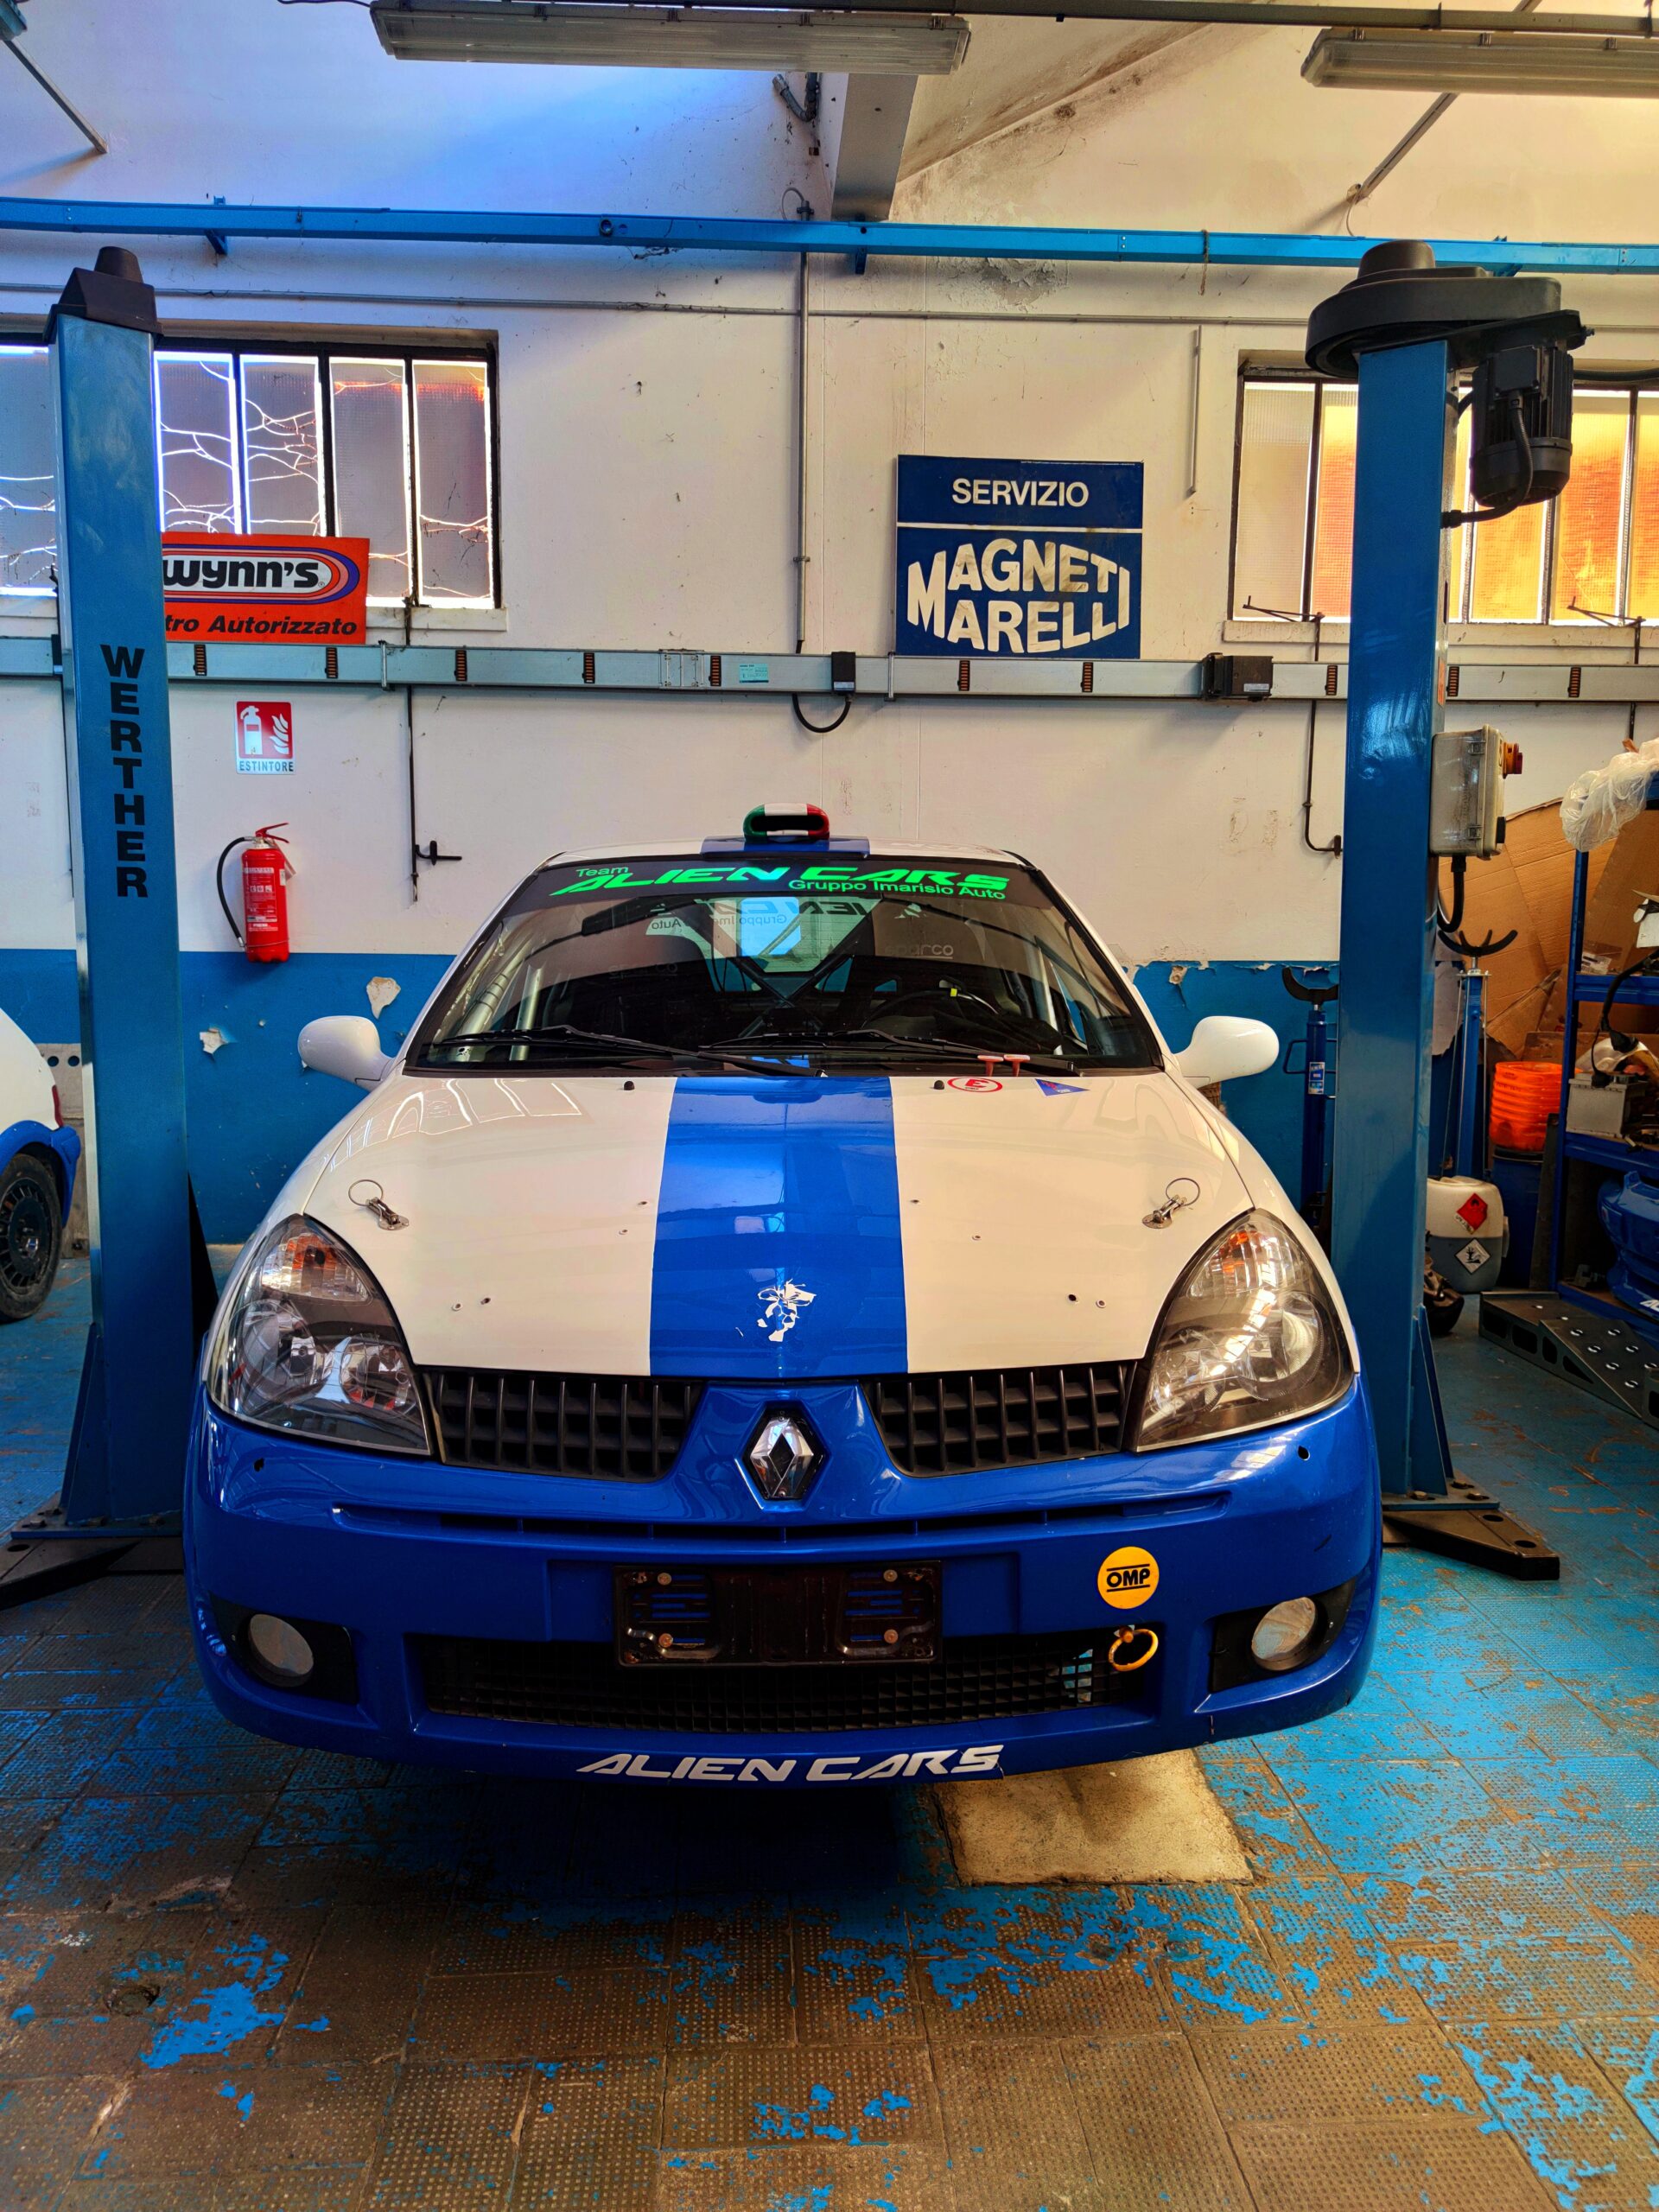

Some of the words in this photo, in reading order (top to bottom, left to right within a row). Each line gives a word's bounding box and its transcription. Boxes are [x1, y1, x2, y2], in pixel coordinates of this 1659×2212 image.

[951, 477, 1090, 507] SERVIZIO
[907, 537, 1130, 639] MAGNETI
[165, 614, 200, 632] tro
[207, 614, 358, 635] Autorizzato
[99, 644, 149, 898] WERTHER
[238, 760, 295, 772] ESTINTORE
[549, 867, 791, 896] ALIEN
[800, 867, 1009, 891] CARS
[575, 867, 629, 877] Team
[789, 880, 867, 892] Gruppo
[958, 886, 1006, 899] Auto
[1106, 1568, 1151, 1588] OMP
[576, 1753, 797, 1782] ALIEN
[806, 1745, 1004, 1781] CARS
